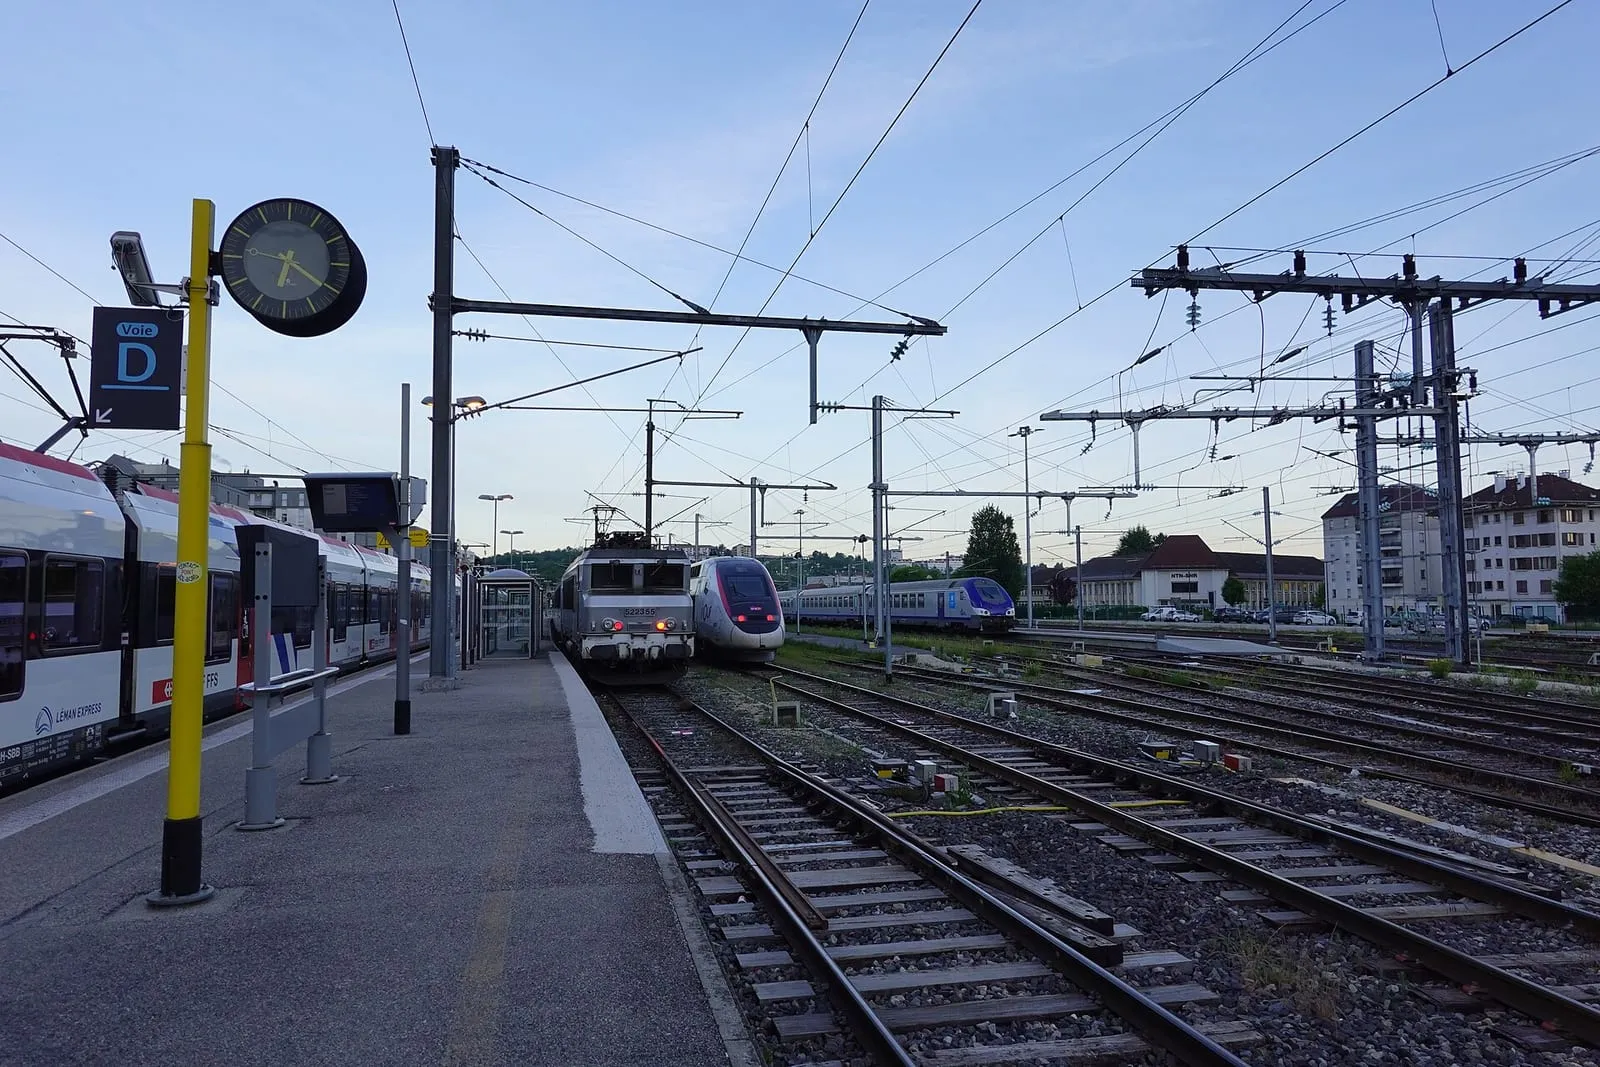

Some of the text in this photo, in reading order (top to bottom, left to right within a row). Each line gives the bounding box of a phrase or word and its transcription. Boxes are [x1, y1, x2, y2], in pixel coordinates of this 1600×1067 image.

[121, 324, 153, 336] Voie
[117, 342, 157, 383] D
[206, 672, 219, 688] FFS
[56, 702, 102, 723] LÉMAN EXPRESS
[0, 747, 21, 761] H-SBB
